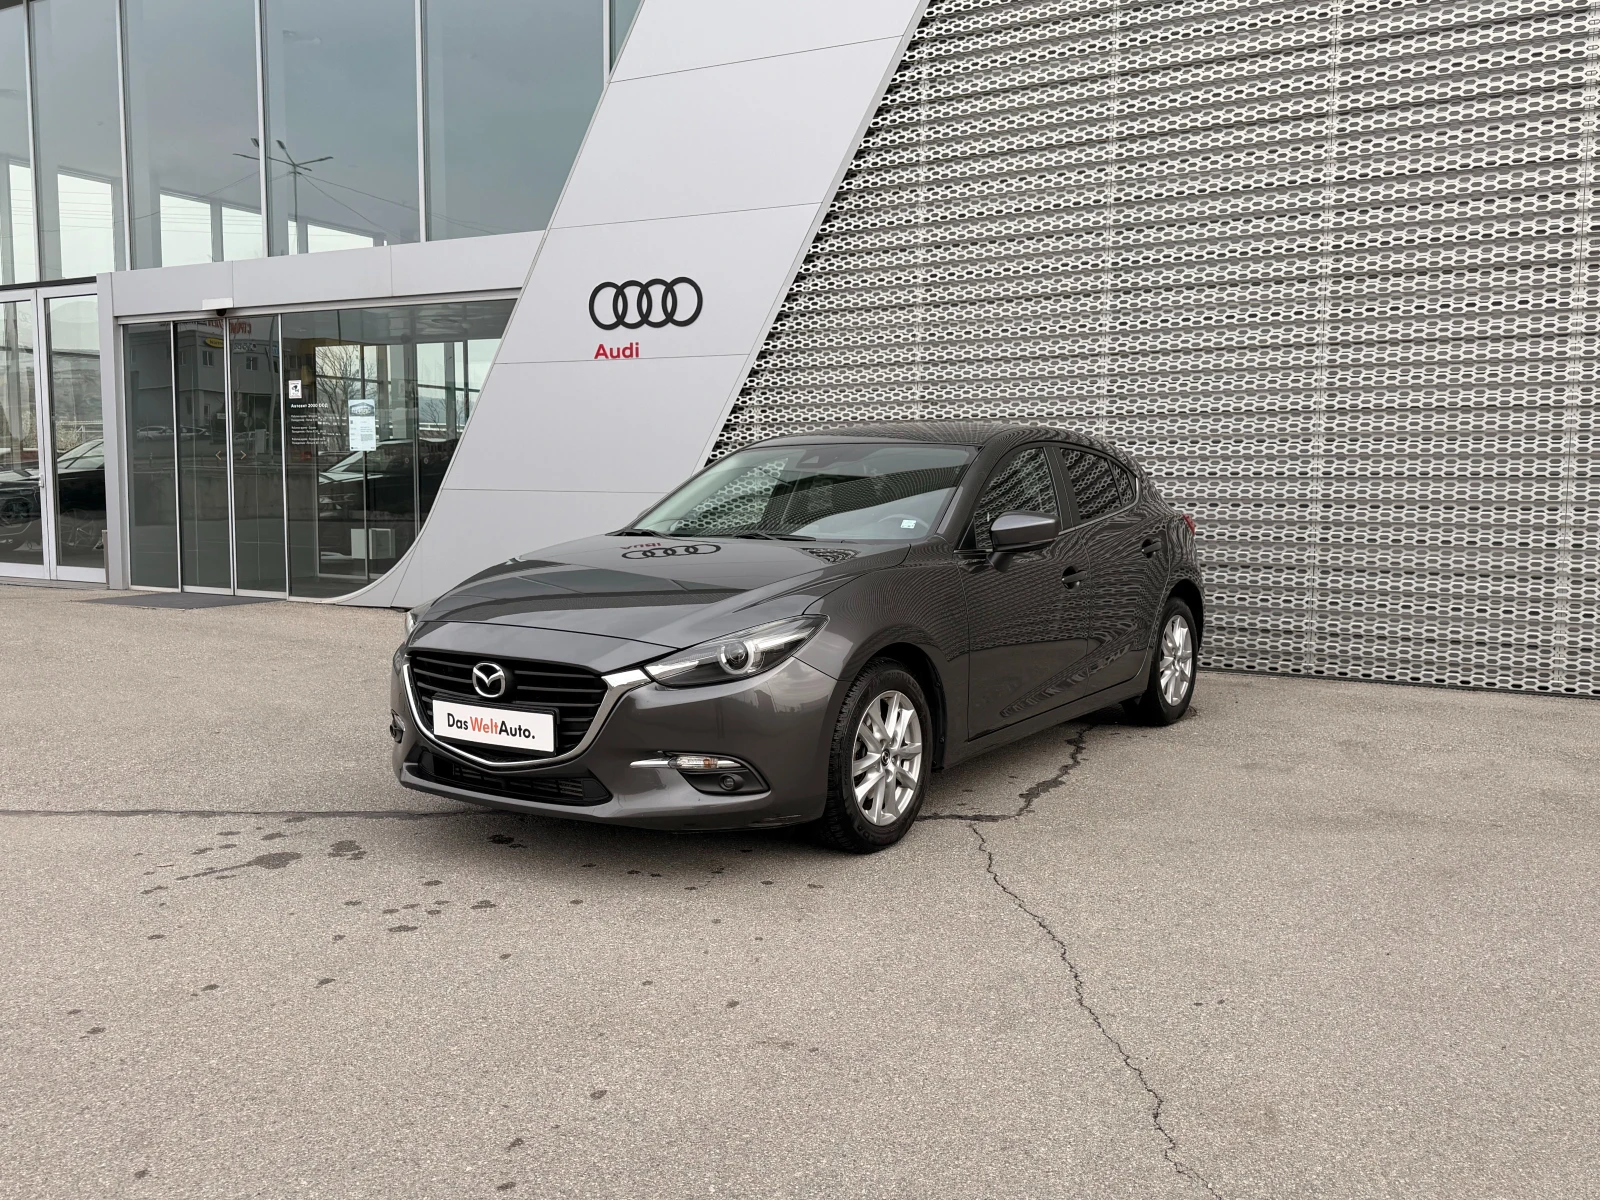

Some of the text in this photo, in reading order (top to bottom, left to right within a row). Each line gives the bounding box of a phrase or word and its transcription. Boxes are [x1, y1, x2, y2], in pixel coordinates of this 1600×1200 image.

[594, 342, 640, 359] Audi
[447, 713, 536, 739] Das WeltAuto.
